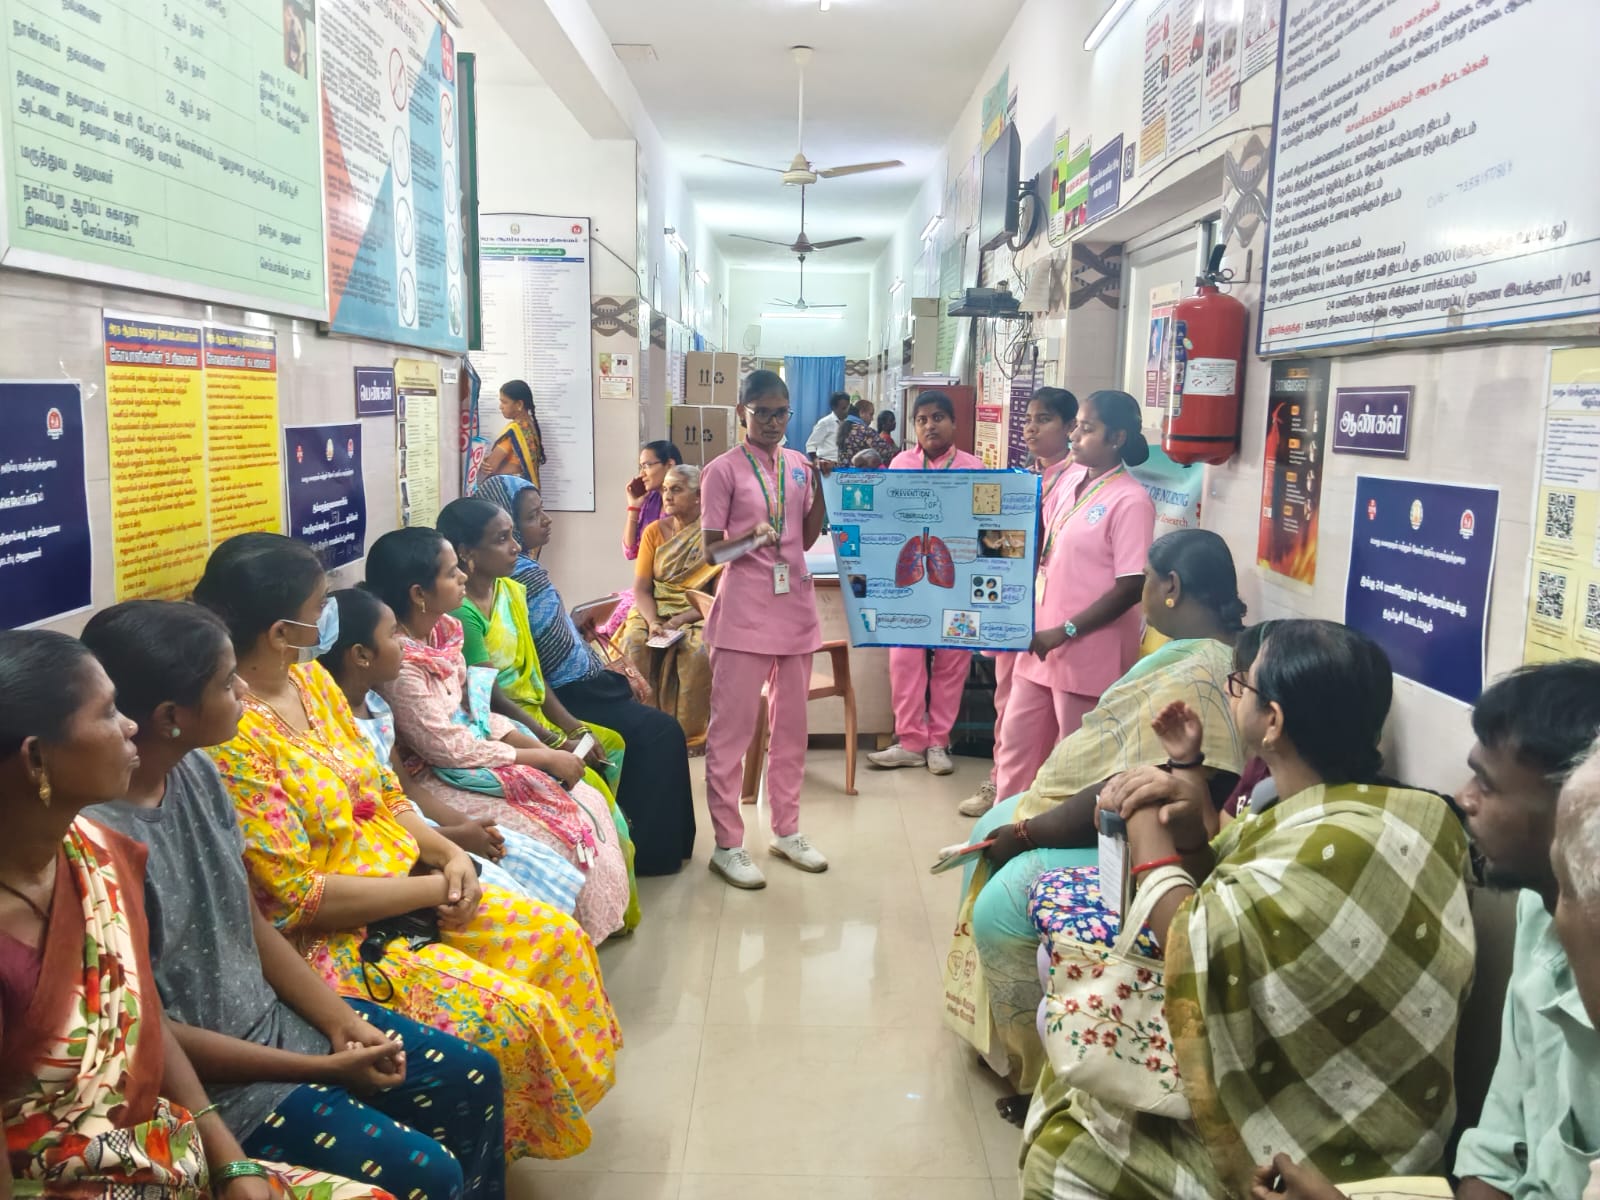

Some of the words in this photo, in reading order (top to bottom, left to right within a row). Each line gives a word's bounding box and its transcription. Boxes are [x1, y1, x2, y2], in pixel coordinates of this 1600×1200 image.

[1427, 112, 1450, 134] திட்டம்
[1450, 121, 1477, 145] திட்டம்
[1380, 187, 1402, 207] திட்டம்
[1336, 250, 1375, 269] Communicable
[1377, 246, 1401, 259] Disease
[1388, 258, 1409, 276] திட்டம்
[1423, 249, 1451, 266] 18000
[1326, 301, 1335, 311] 24
[1388, 284, 1420, 300] சிகிச்சை
[1421, 271, 1477, 293] பார்க்கப்படும்
[1466, 288, 1502, 308] துணை
[360, 379, 392, 402] பெண்கள்
[1339, 404, 1403, 437] ஆண்கள்
[889, 489, 930, 497] PREVENTION
[928, 501, 937, 509] OF
[1376, 580, 1384, 591] 24
